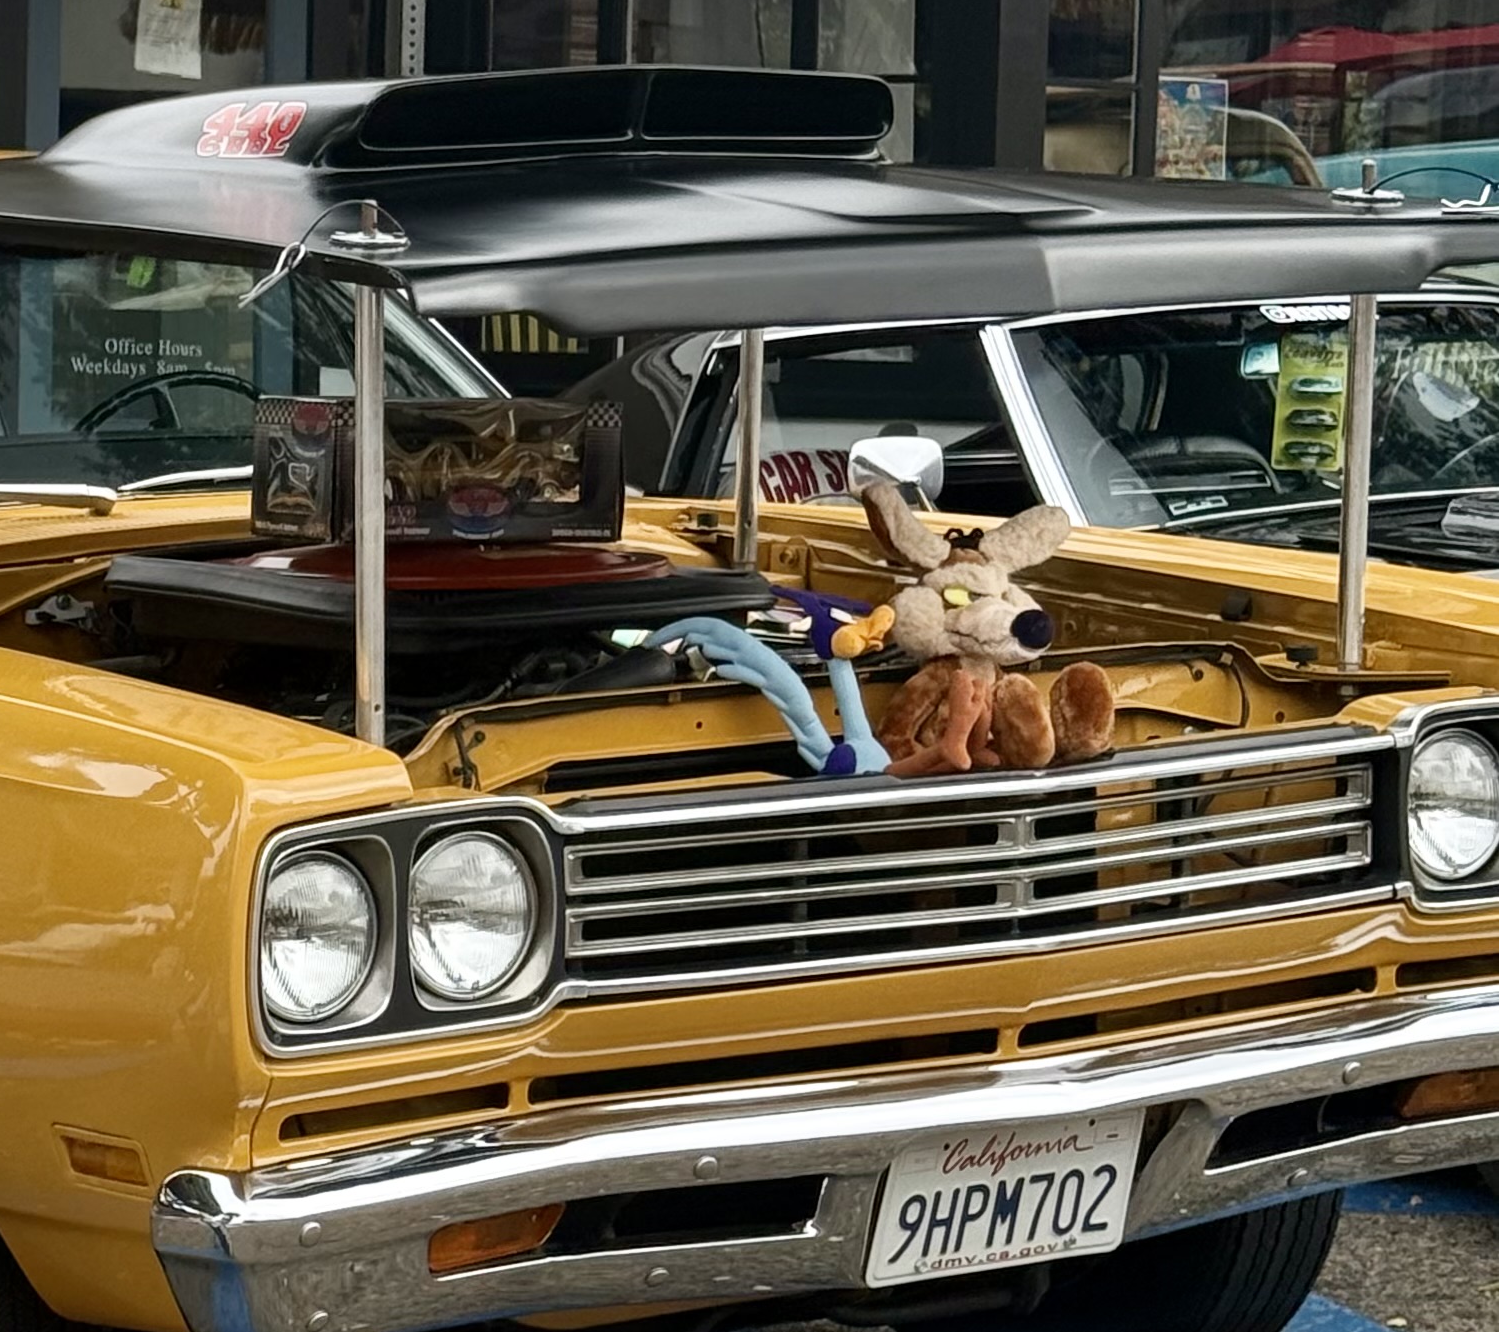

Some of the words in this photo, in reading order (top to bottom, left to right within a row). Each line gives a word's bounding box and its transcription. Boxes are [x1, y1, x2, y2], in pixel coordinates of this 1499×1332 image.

[202, 101, 307, 141] 440
[70, 352, 147, 379] Weekdays
[156, 360, 189, 376] 8am
[104, 337, 152, 356] Office
[158, 339, 202, 357] Hours
[759, 451, 819, 504] CAR
[942, 1130, 1094, 1177] California
[887, 1164, 1118, 1265] 9HPM702
[930, 1240, 1059, 1270] dmv.ca.gov
